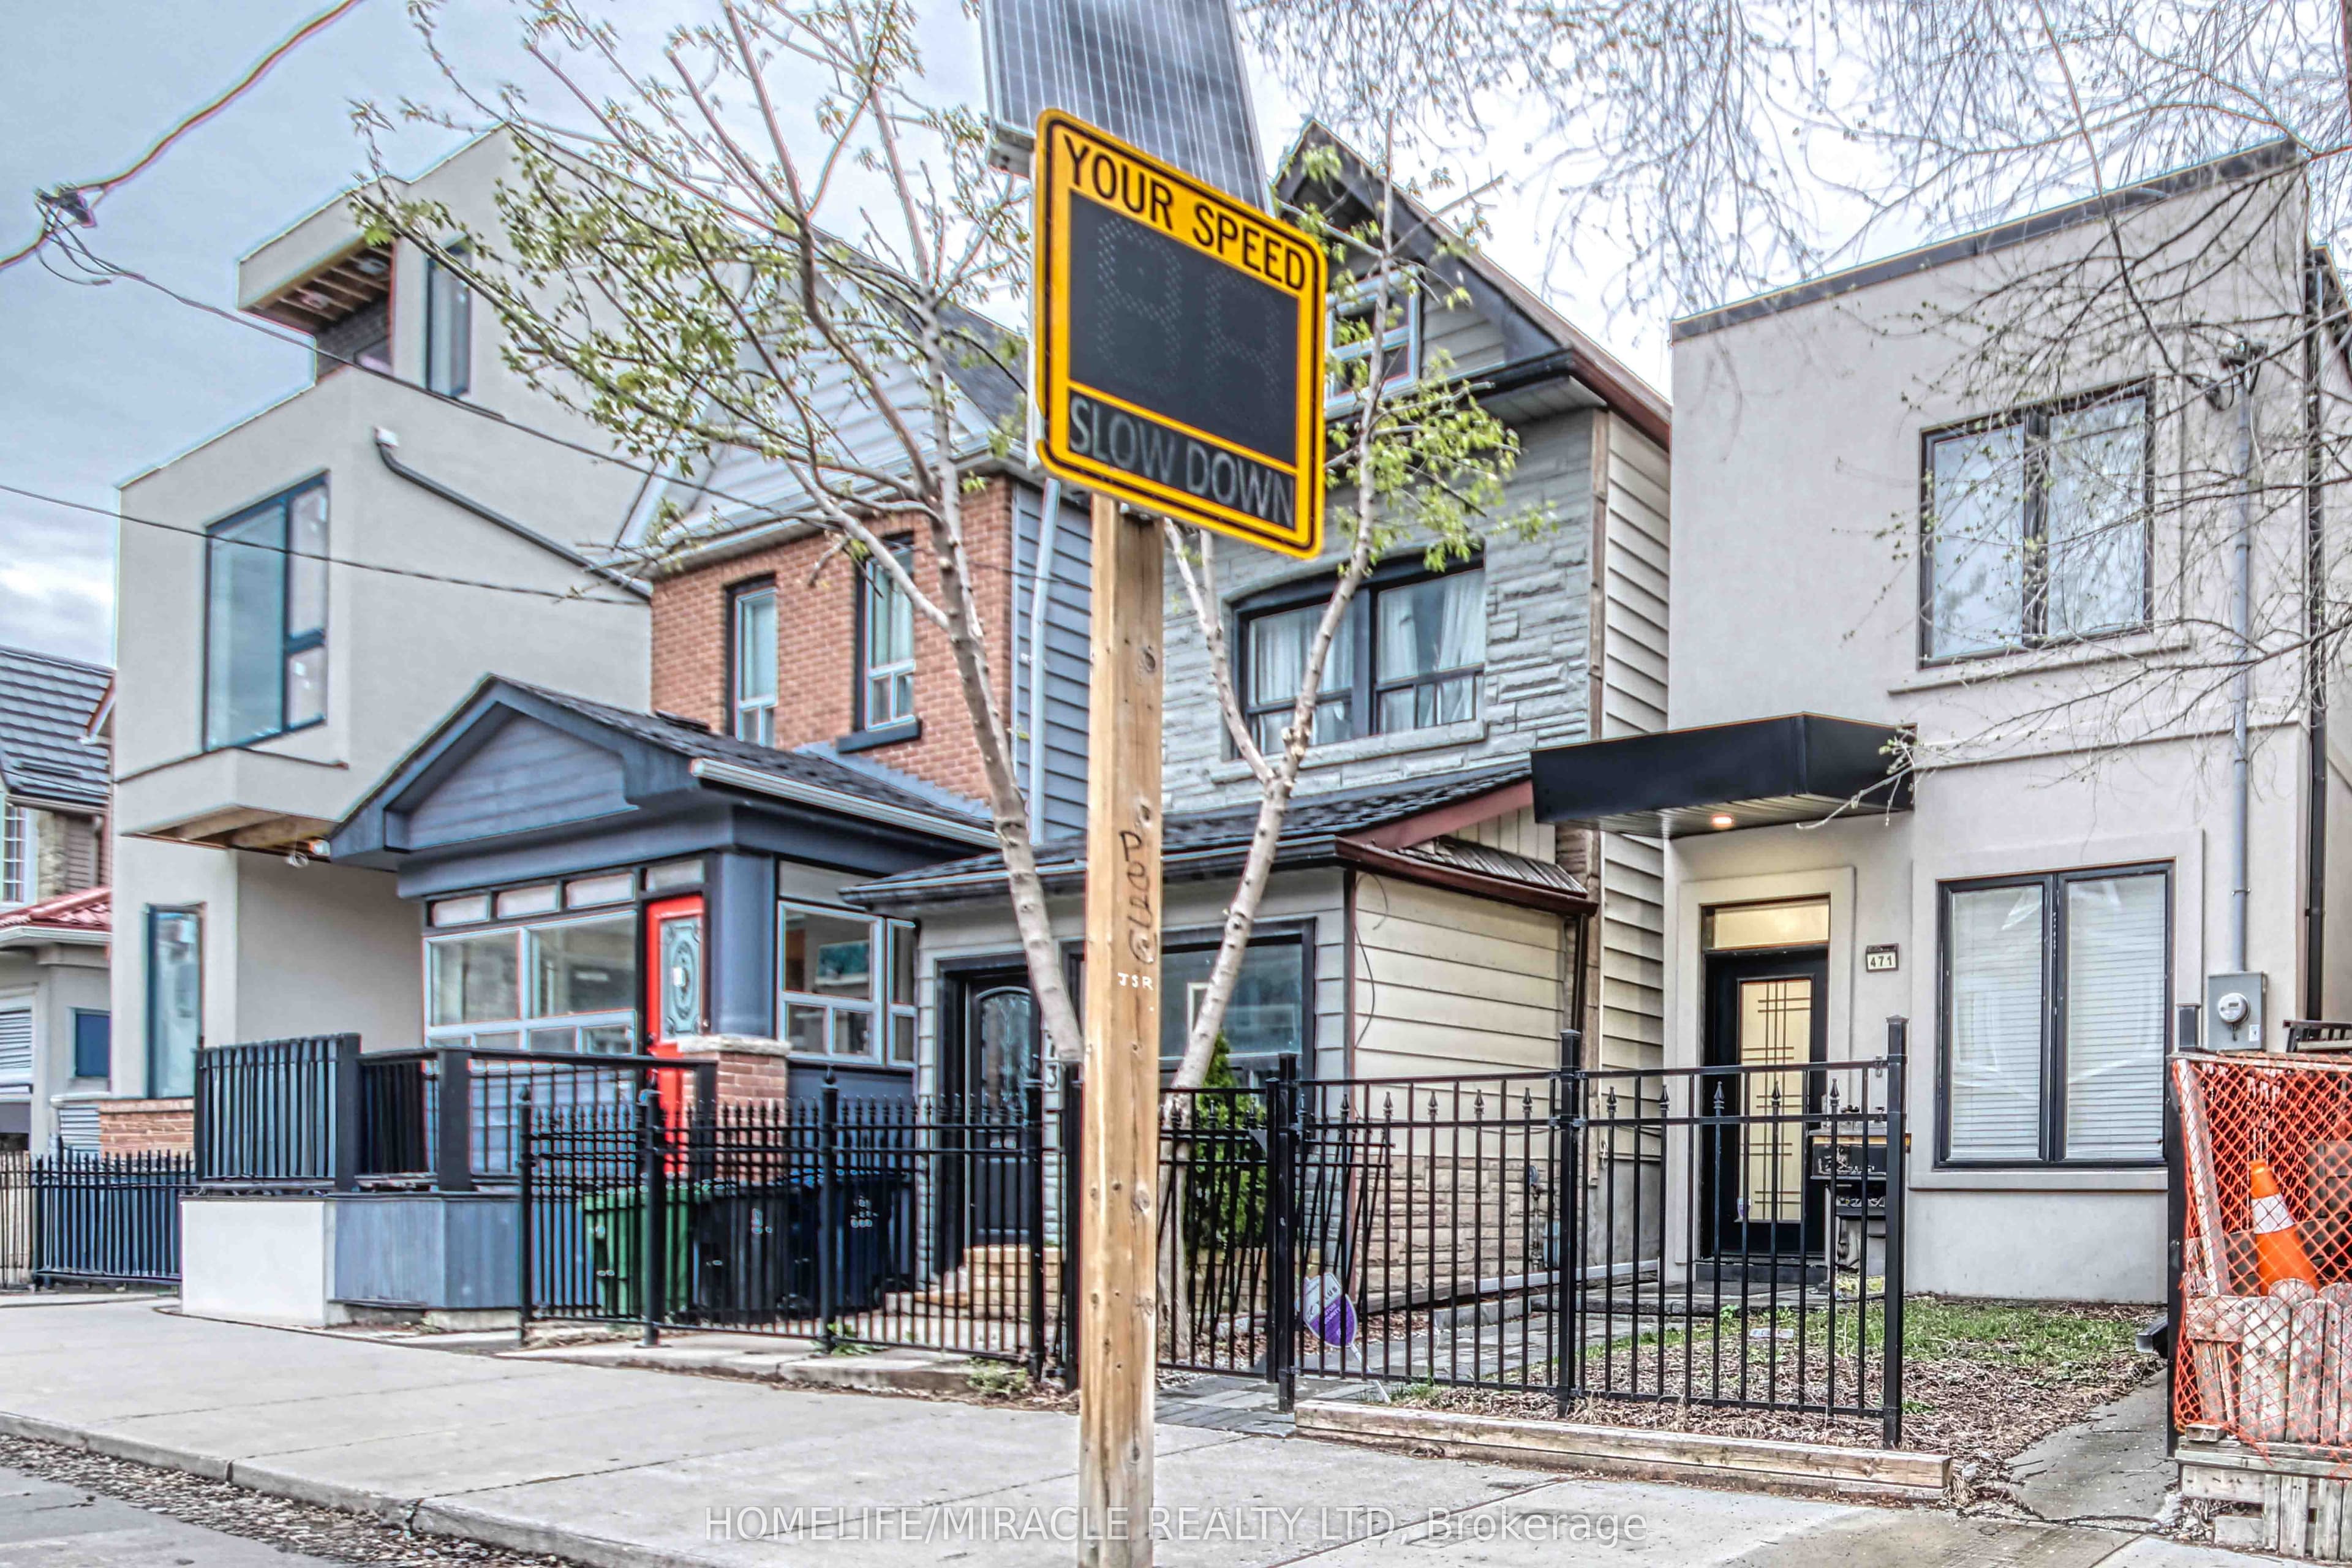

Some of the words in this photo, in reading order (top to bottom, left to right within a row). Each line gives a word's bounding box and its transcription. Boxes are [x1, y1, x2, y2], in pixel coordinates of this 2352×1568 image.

[1063, 133, 1174, 231] YOUR
[1192, 202, 1306, 292] SPEED
[1069, 394, 1175, 485] SLOW
[1185, 438, 1295, 528] DOWN
[1117, 971, 1154, 991] JSR
[1870, 955, 1893, 967] 471
